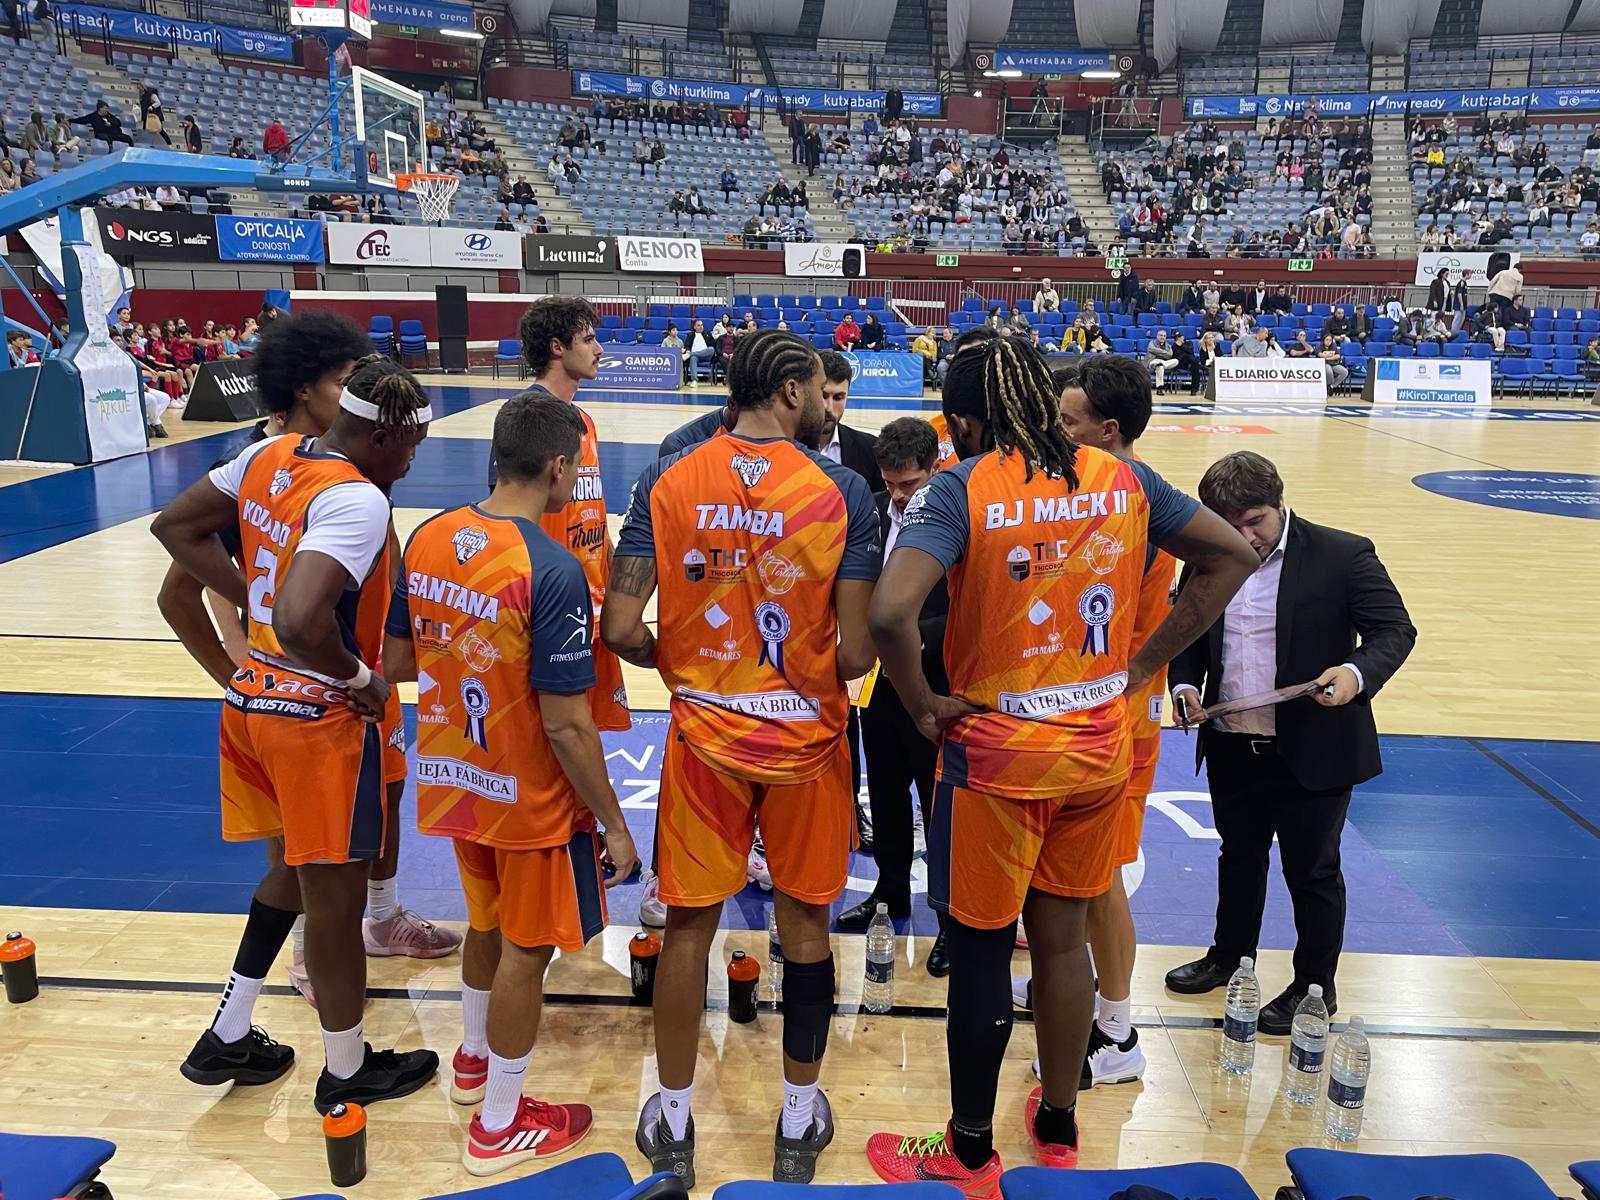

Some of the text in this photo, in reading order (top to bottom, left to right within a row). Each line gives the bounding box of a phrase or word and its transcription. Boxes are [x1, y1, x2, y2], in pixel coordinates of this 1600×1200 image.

[371, 4, 468, 23] AMENABAR arena
[978, 58, 987, 66] 10
[1122, 59, 1131, 68] 10
[669, 84, 730, 100] Naturklima
[764, 94, 886, 108] nveready kutxaban
[1284, 100, 1350, 112] Natklima
[1386, 98, 1445, 110] Inveready
[284, 178, 310, 186] MONDO
[128, 229, 172, 243] NGS
[252, 241, 290, 250] DONOSTI
[624, 240, 698, 259] AENOR
[626, 356, 671, 366] GANBOA
[862, 360, 892, 368] ORAIN
[1219, 369, 1322, 379] EL DIARIO VASCO
[1399, 390, 1474, 402] #KirolTxartela
[986, 490, 1128, 530] BJ MACK II
[696, 504, 784, 537] TAMBA
[1034, 539, 1068, 560] THC
[709, 548, 747, 568] THC
[249, 546, 278, 624] 2
[408, 570, 499, 624] SANTANA
[421, 618, 452, 641] THC
[550, 652, 574, 662] FITNESS
[700, 648, 742, 660] RETAMARES
[1022, 643, 1064, 658] RETAMARES
[1005, 679, 1125, 714] LA VIEJA FÁBRICA
[750, 696, 816, 712] FÁBRICA
[417, 764, 511, 795] IEJA FÁBRICA
